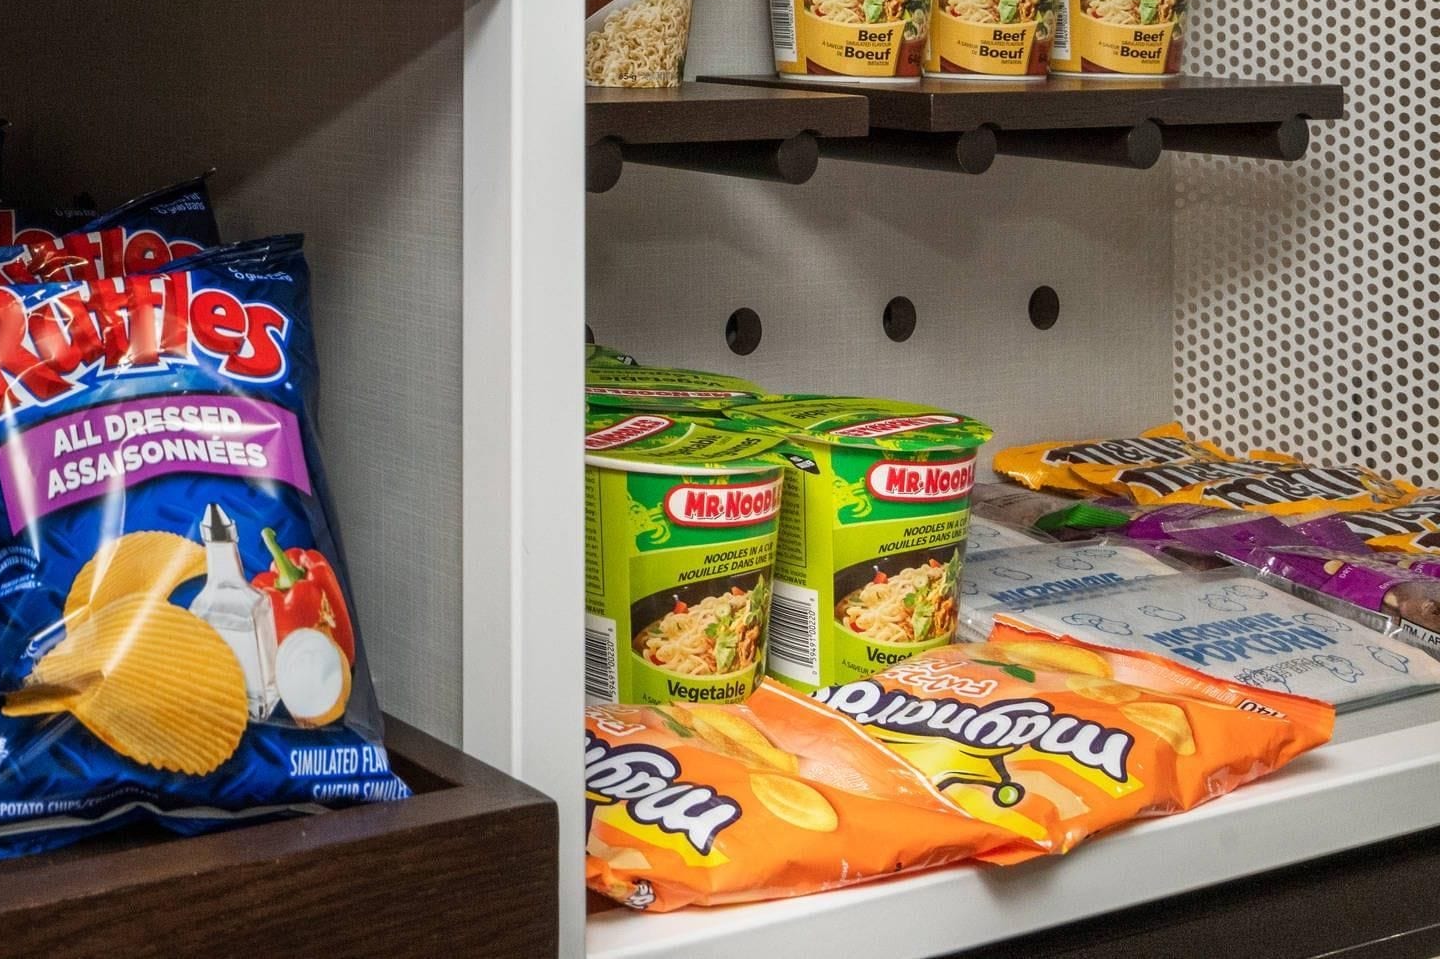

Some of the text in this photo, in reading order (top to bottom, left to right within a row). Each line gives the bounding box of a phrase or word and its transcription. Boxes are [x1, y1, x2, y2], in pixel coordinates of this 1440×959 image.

[857, 30, 894, 42] Beef
[992, 30, 1027, 42] Beef
[1133, 31, 1164, 42] Beef
[844, 46, 892, 60] Boeuf
[978, 46, 1025, 60] Boeuf
[1120, 46, 1162, 59] Boeuf
[53, 405, 243, 458] ALL DRESSED
[47, 435, 268, 500] ASSAISONNÉES
[903, 520, 955, 537] NOODLES IN
[878, 535, 928, 553] NOUILLES
[928, 533, 951, 545] DANS
[703, 547, 758, 565] NOODLES IN
[678, 555, 768, 582] NOUILLES DANS UNE
[1147, 611, 1299, 648] MICROWAVE
[1171, 623, 1340, 667] POPCORN
[667, 679, 746, 703] Vegetable
[290, 748, 359, 777] SIMULATED
[0, 801, 44, 817] POTATO
